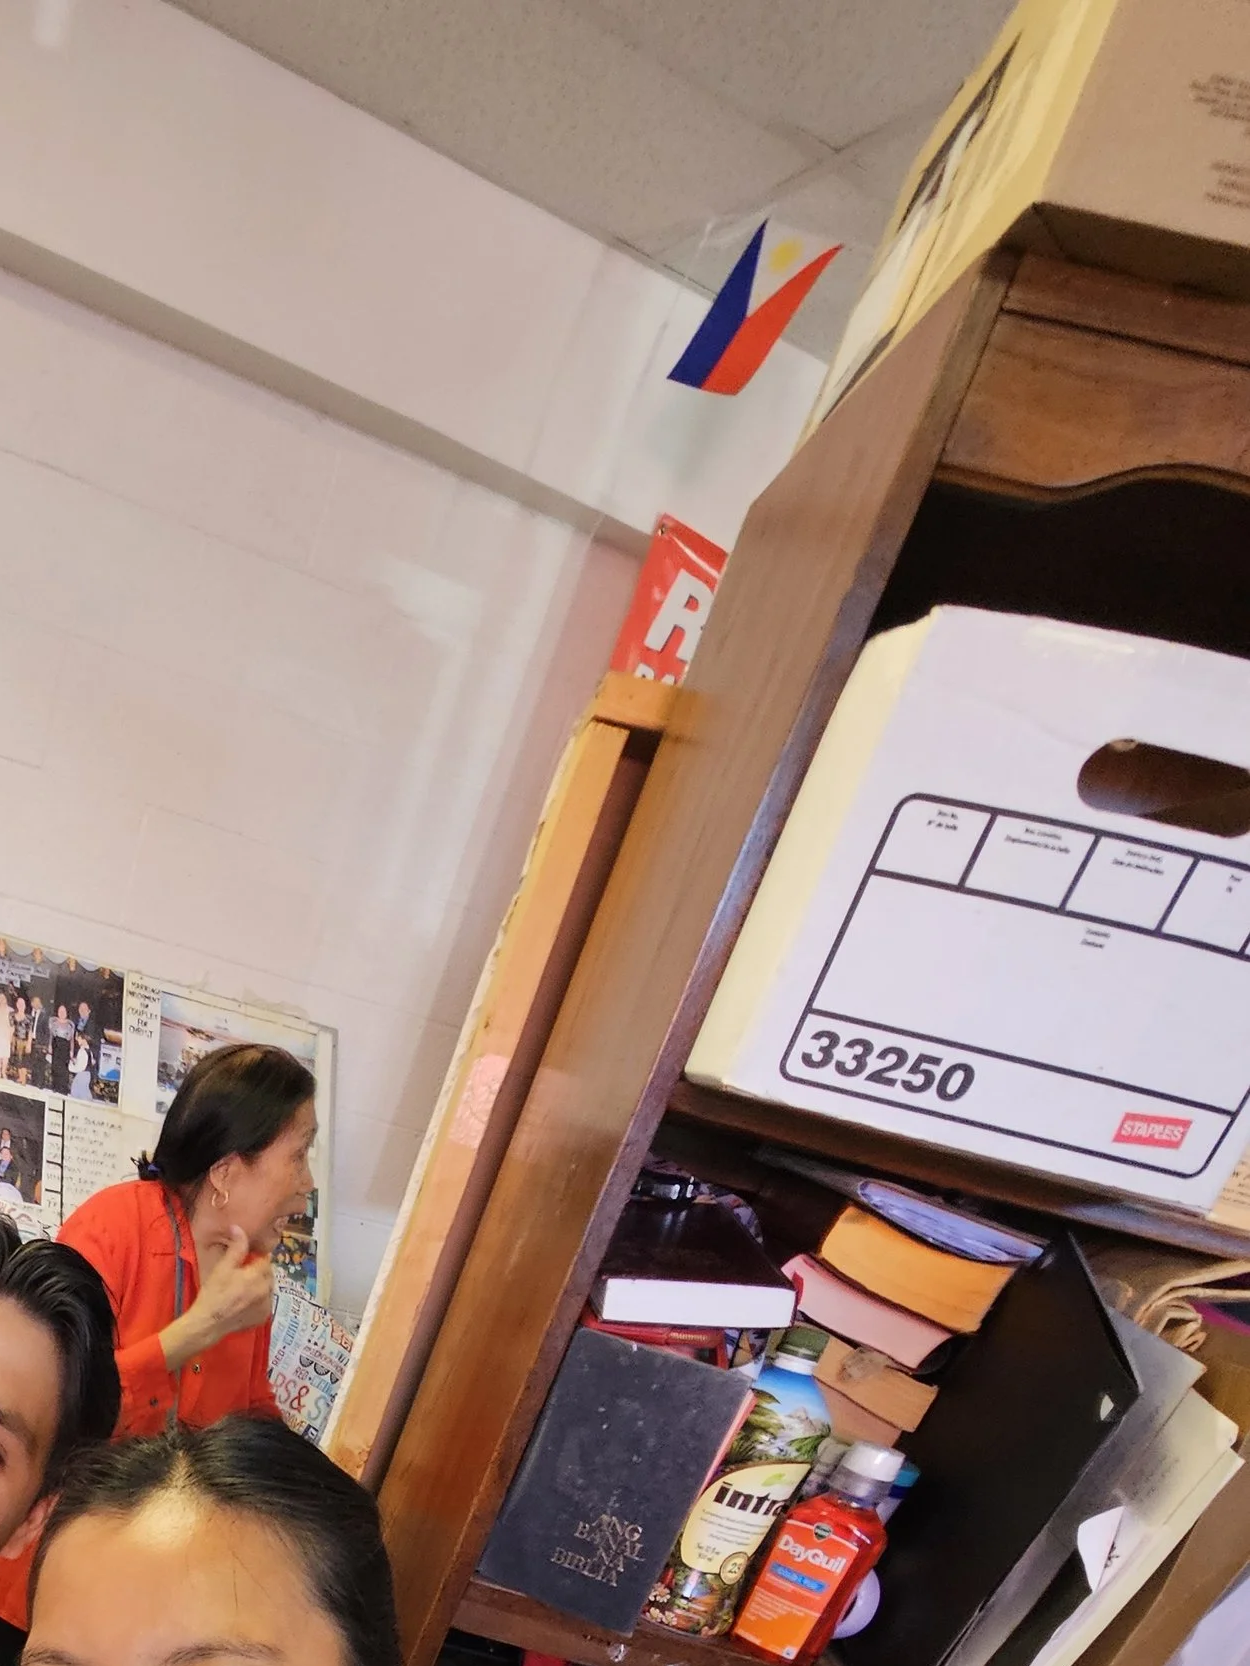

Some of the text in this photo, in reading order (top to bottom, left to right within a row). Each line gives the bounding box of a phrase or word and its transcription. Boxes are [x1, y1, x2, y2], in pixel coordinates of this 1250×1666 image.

[800, 1029, 976, 1102] 33250
[1120, 1120, 1184, 1143] STAPLES
[592, 1514, 643, 1541] ANG
[550, 1547, 617, 1587] BIBLIA
[778, 1534, 847, 1574] DayQuil
